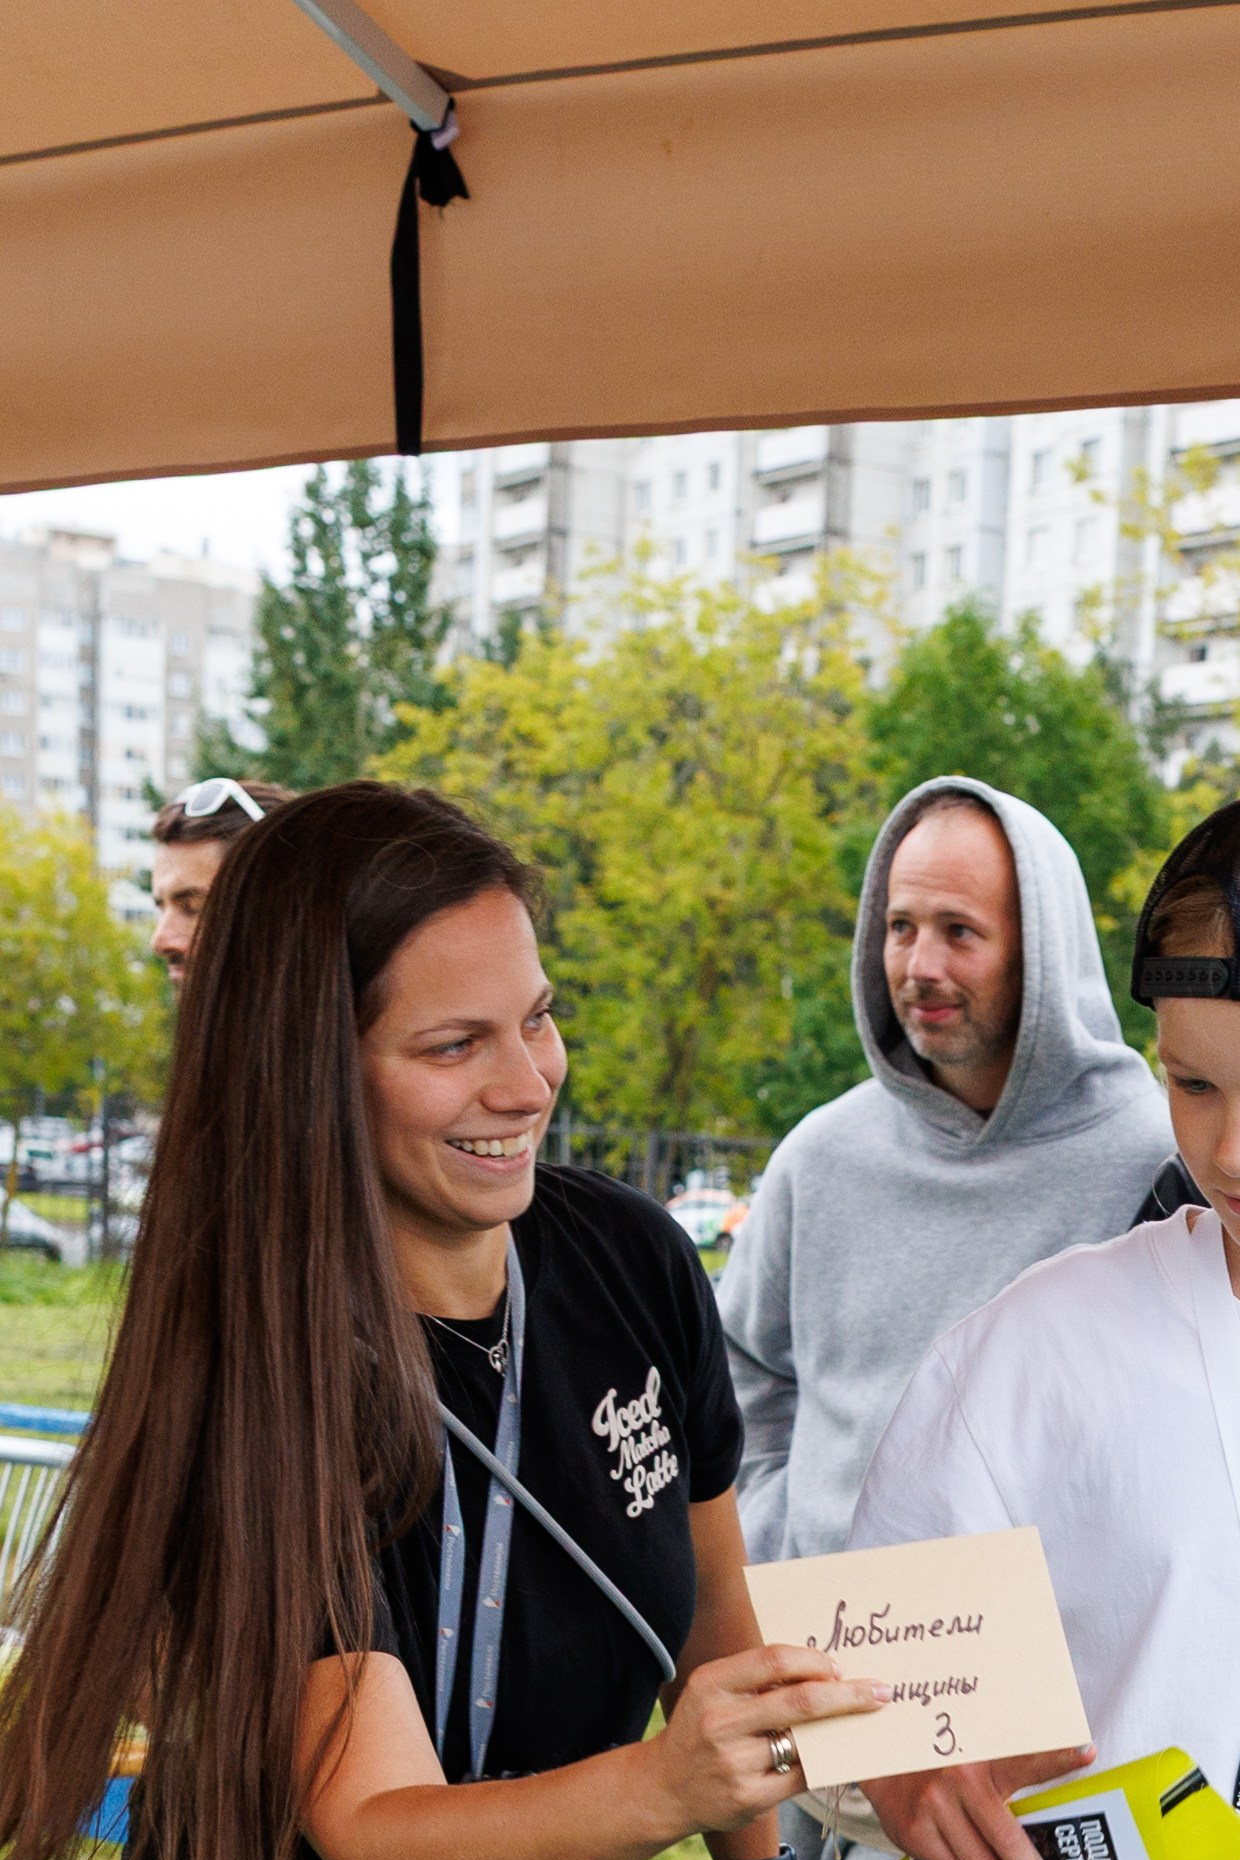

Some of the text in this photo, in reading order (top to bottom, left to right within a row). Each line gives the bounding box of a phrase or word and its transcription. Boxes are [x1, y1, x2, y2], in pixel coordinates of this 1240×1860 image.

[591, 1366, 662, 1452] Iced
[610, 1420, 671, 1480] Matcha
[624, 1450, 679, 1518] Latte
[807, 1600, 984, 1652] Любители
[888, 1676, 978, 1706] нщины
